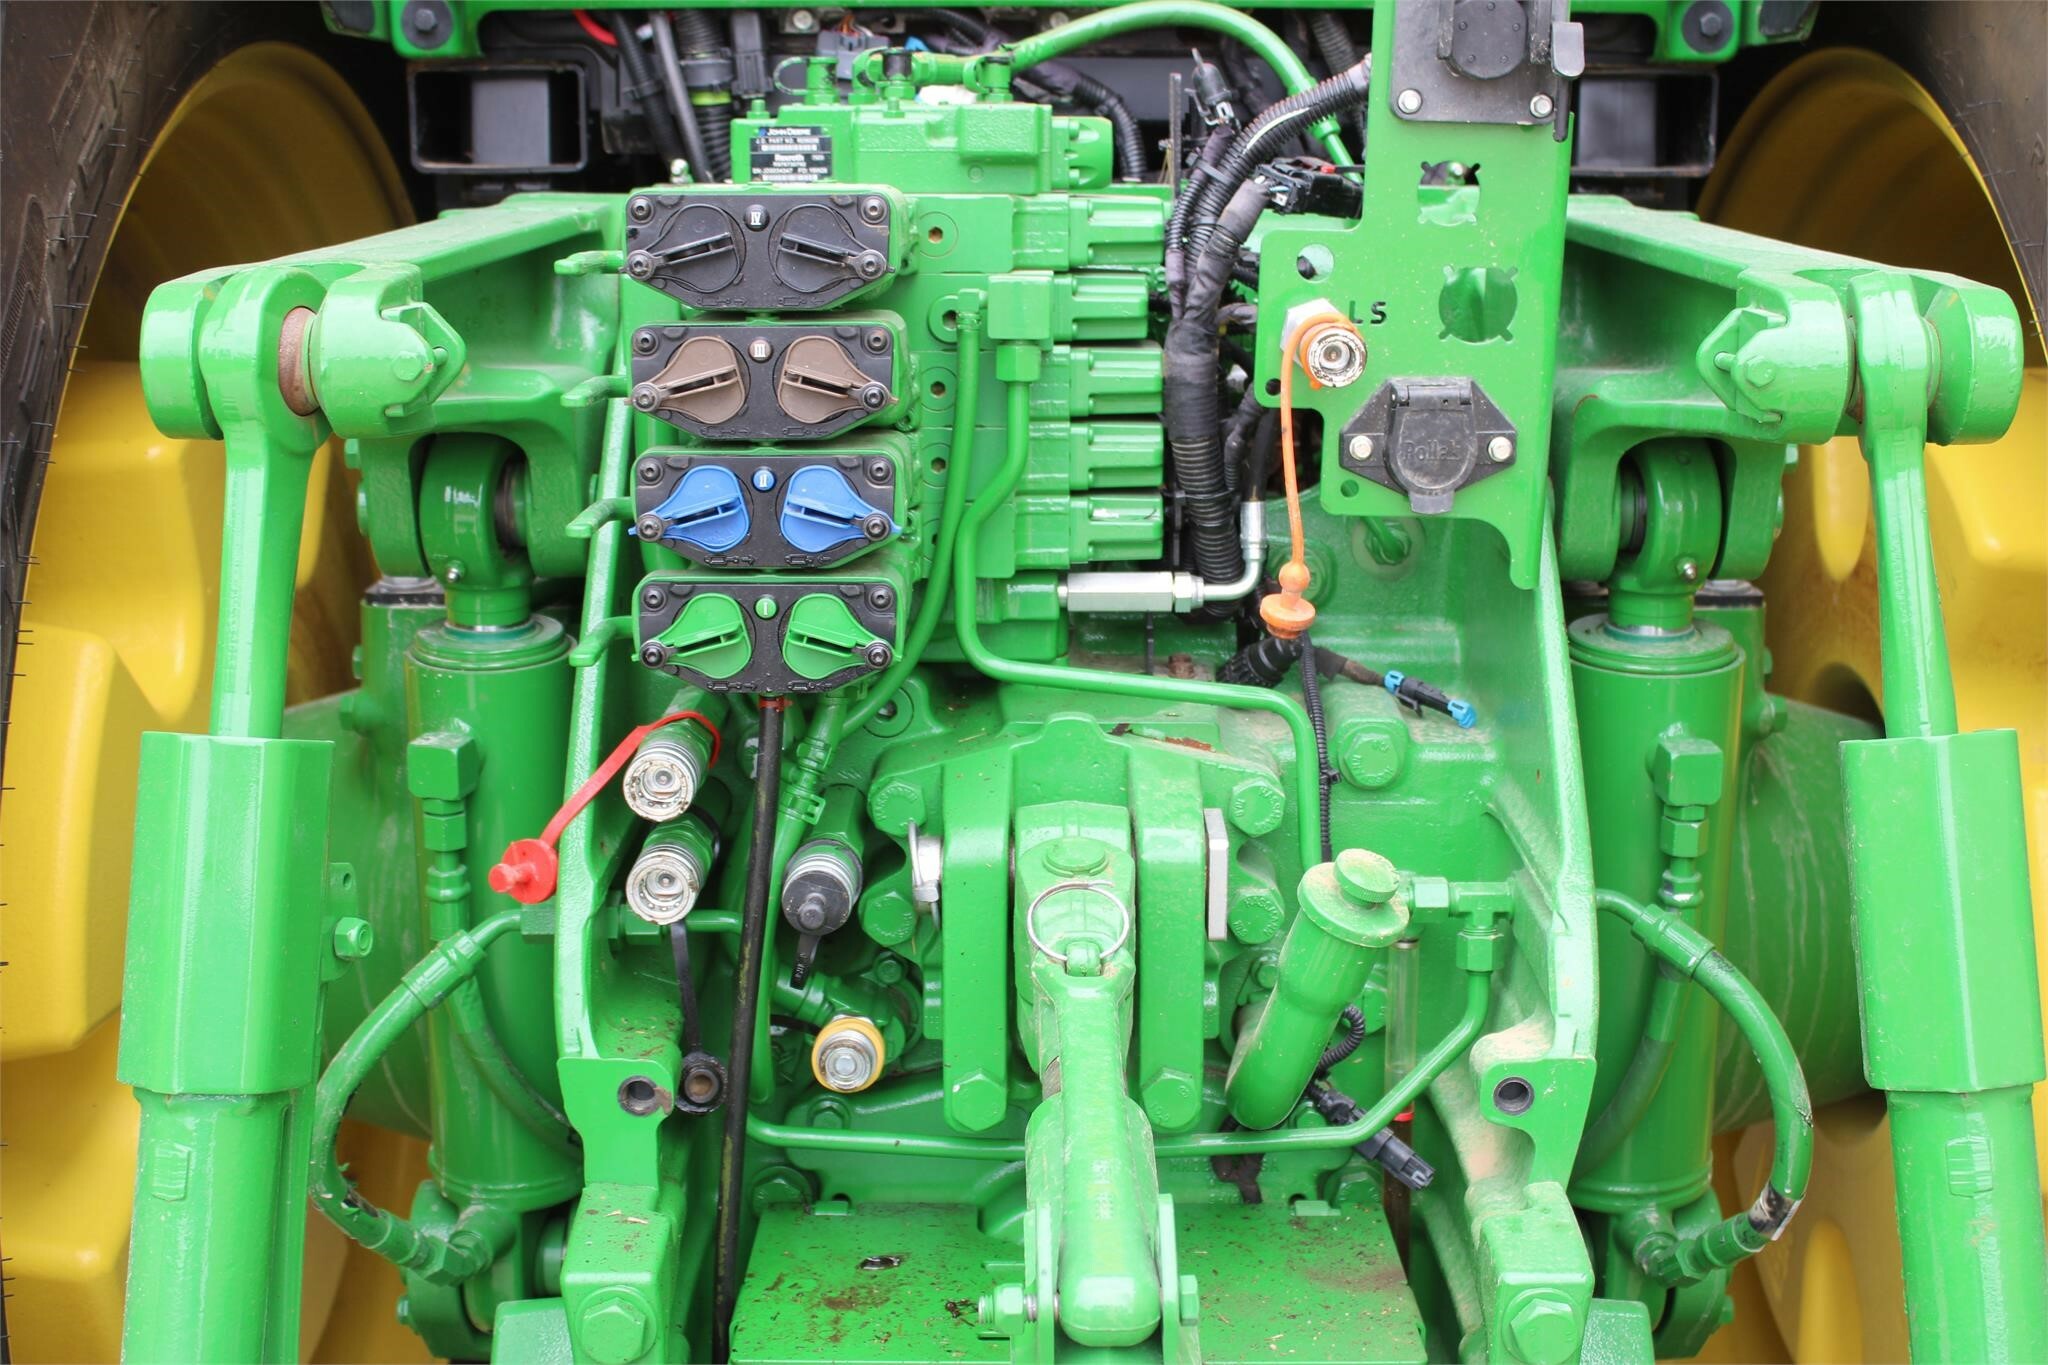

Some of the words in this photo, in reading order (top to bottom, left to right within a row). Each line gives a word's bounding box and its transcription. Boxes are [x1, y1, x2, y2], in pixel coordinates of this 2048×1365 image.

[750, 211, 762, 226] IV
[753, 343, 767, 358] III
[759, 474, 768, 488] II
